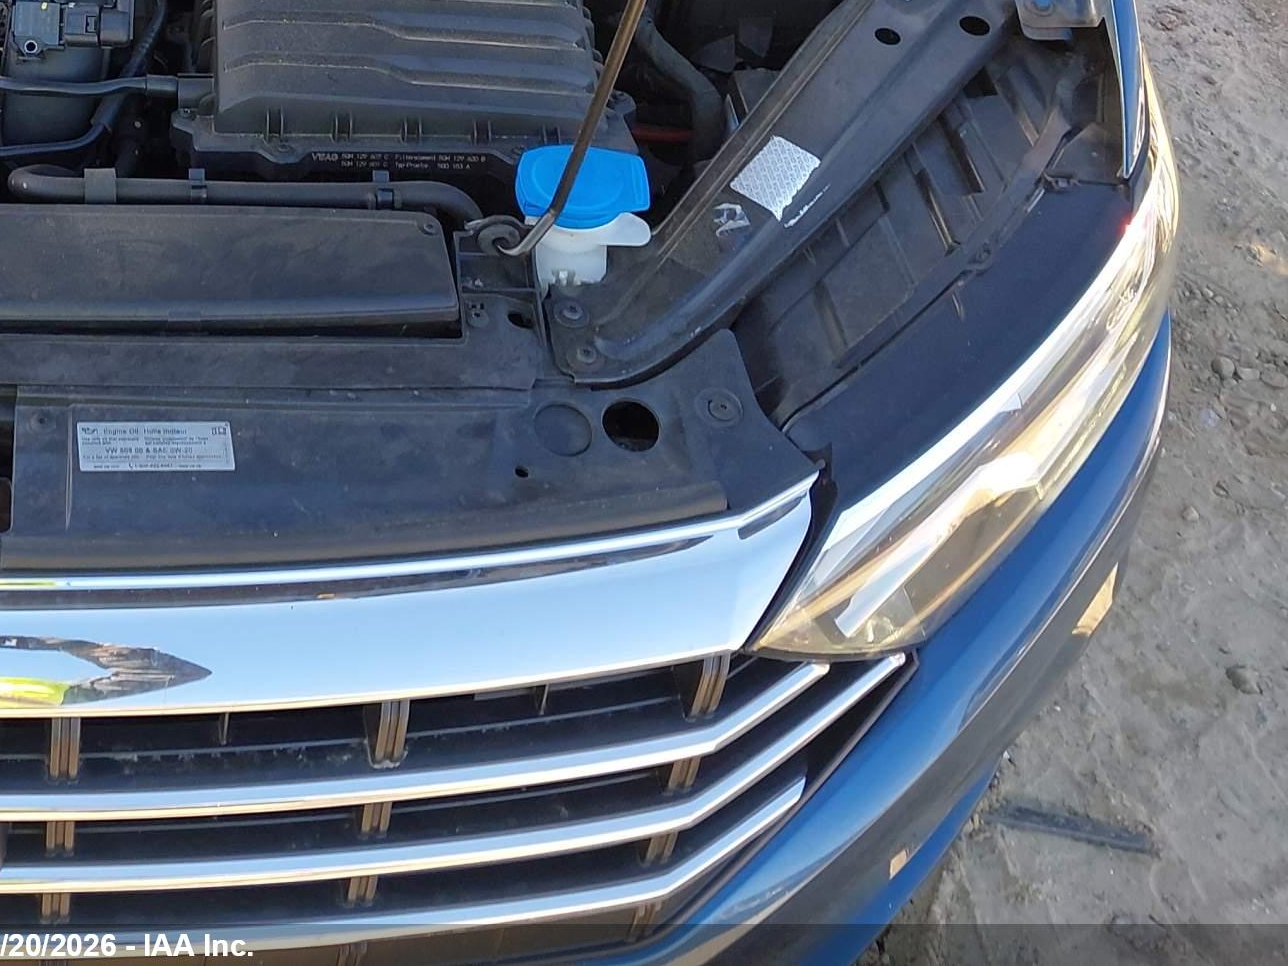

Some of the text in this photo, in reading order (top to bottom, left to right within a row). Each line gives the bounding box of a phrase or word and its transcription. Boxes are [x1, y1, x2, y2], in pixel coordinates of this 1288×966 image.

[103, 427, 126, 436] Engine
[128, 427, 139, 435] Oil
[104, 446, 117, 454] VW
[145, 446, 151, 454] &
